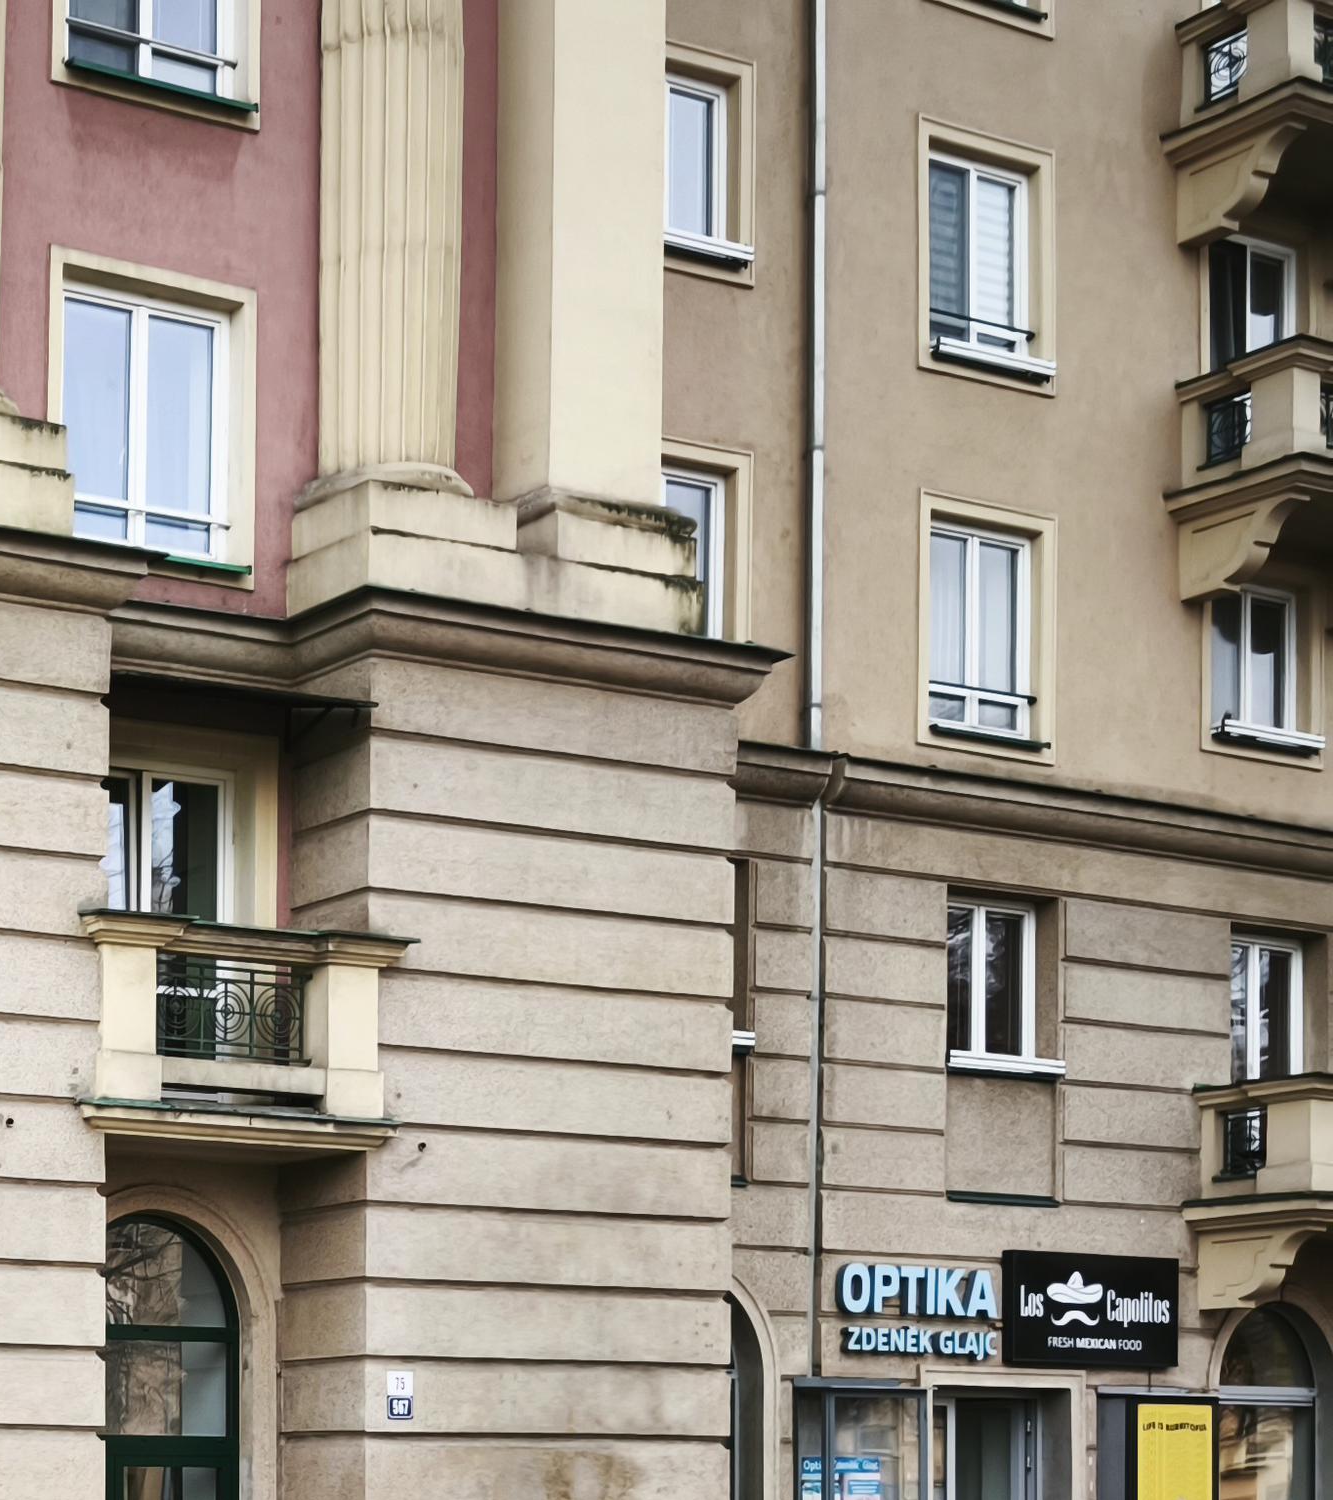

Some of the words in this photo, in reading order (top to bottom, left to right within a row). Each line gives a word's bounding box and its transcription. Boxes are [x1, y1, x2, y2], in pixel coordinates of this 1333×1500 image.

[842, 1262, 998, 1319] OPTIKA
[1020, 1284, 1044, 1318] Los
[1106, 1289, 1170, 1328] Capolitos
[847, 1325, 934, 1353] ZDENĚK
[939, 1330, 998, 1361] GLAJC
[1047, 1336, 1074, 1348] FRESH
[1075, 1337, 1117, 1350] MEXICAN
[1118, 1339, 1143, 1351] FOOD
